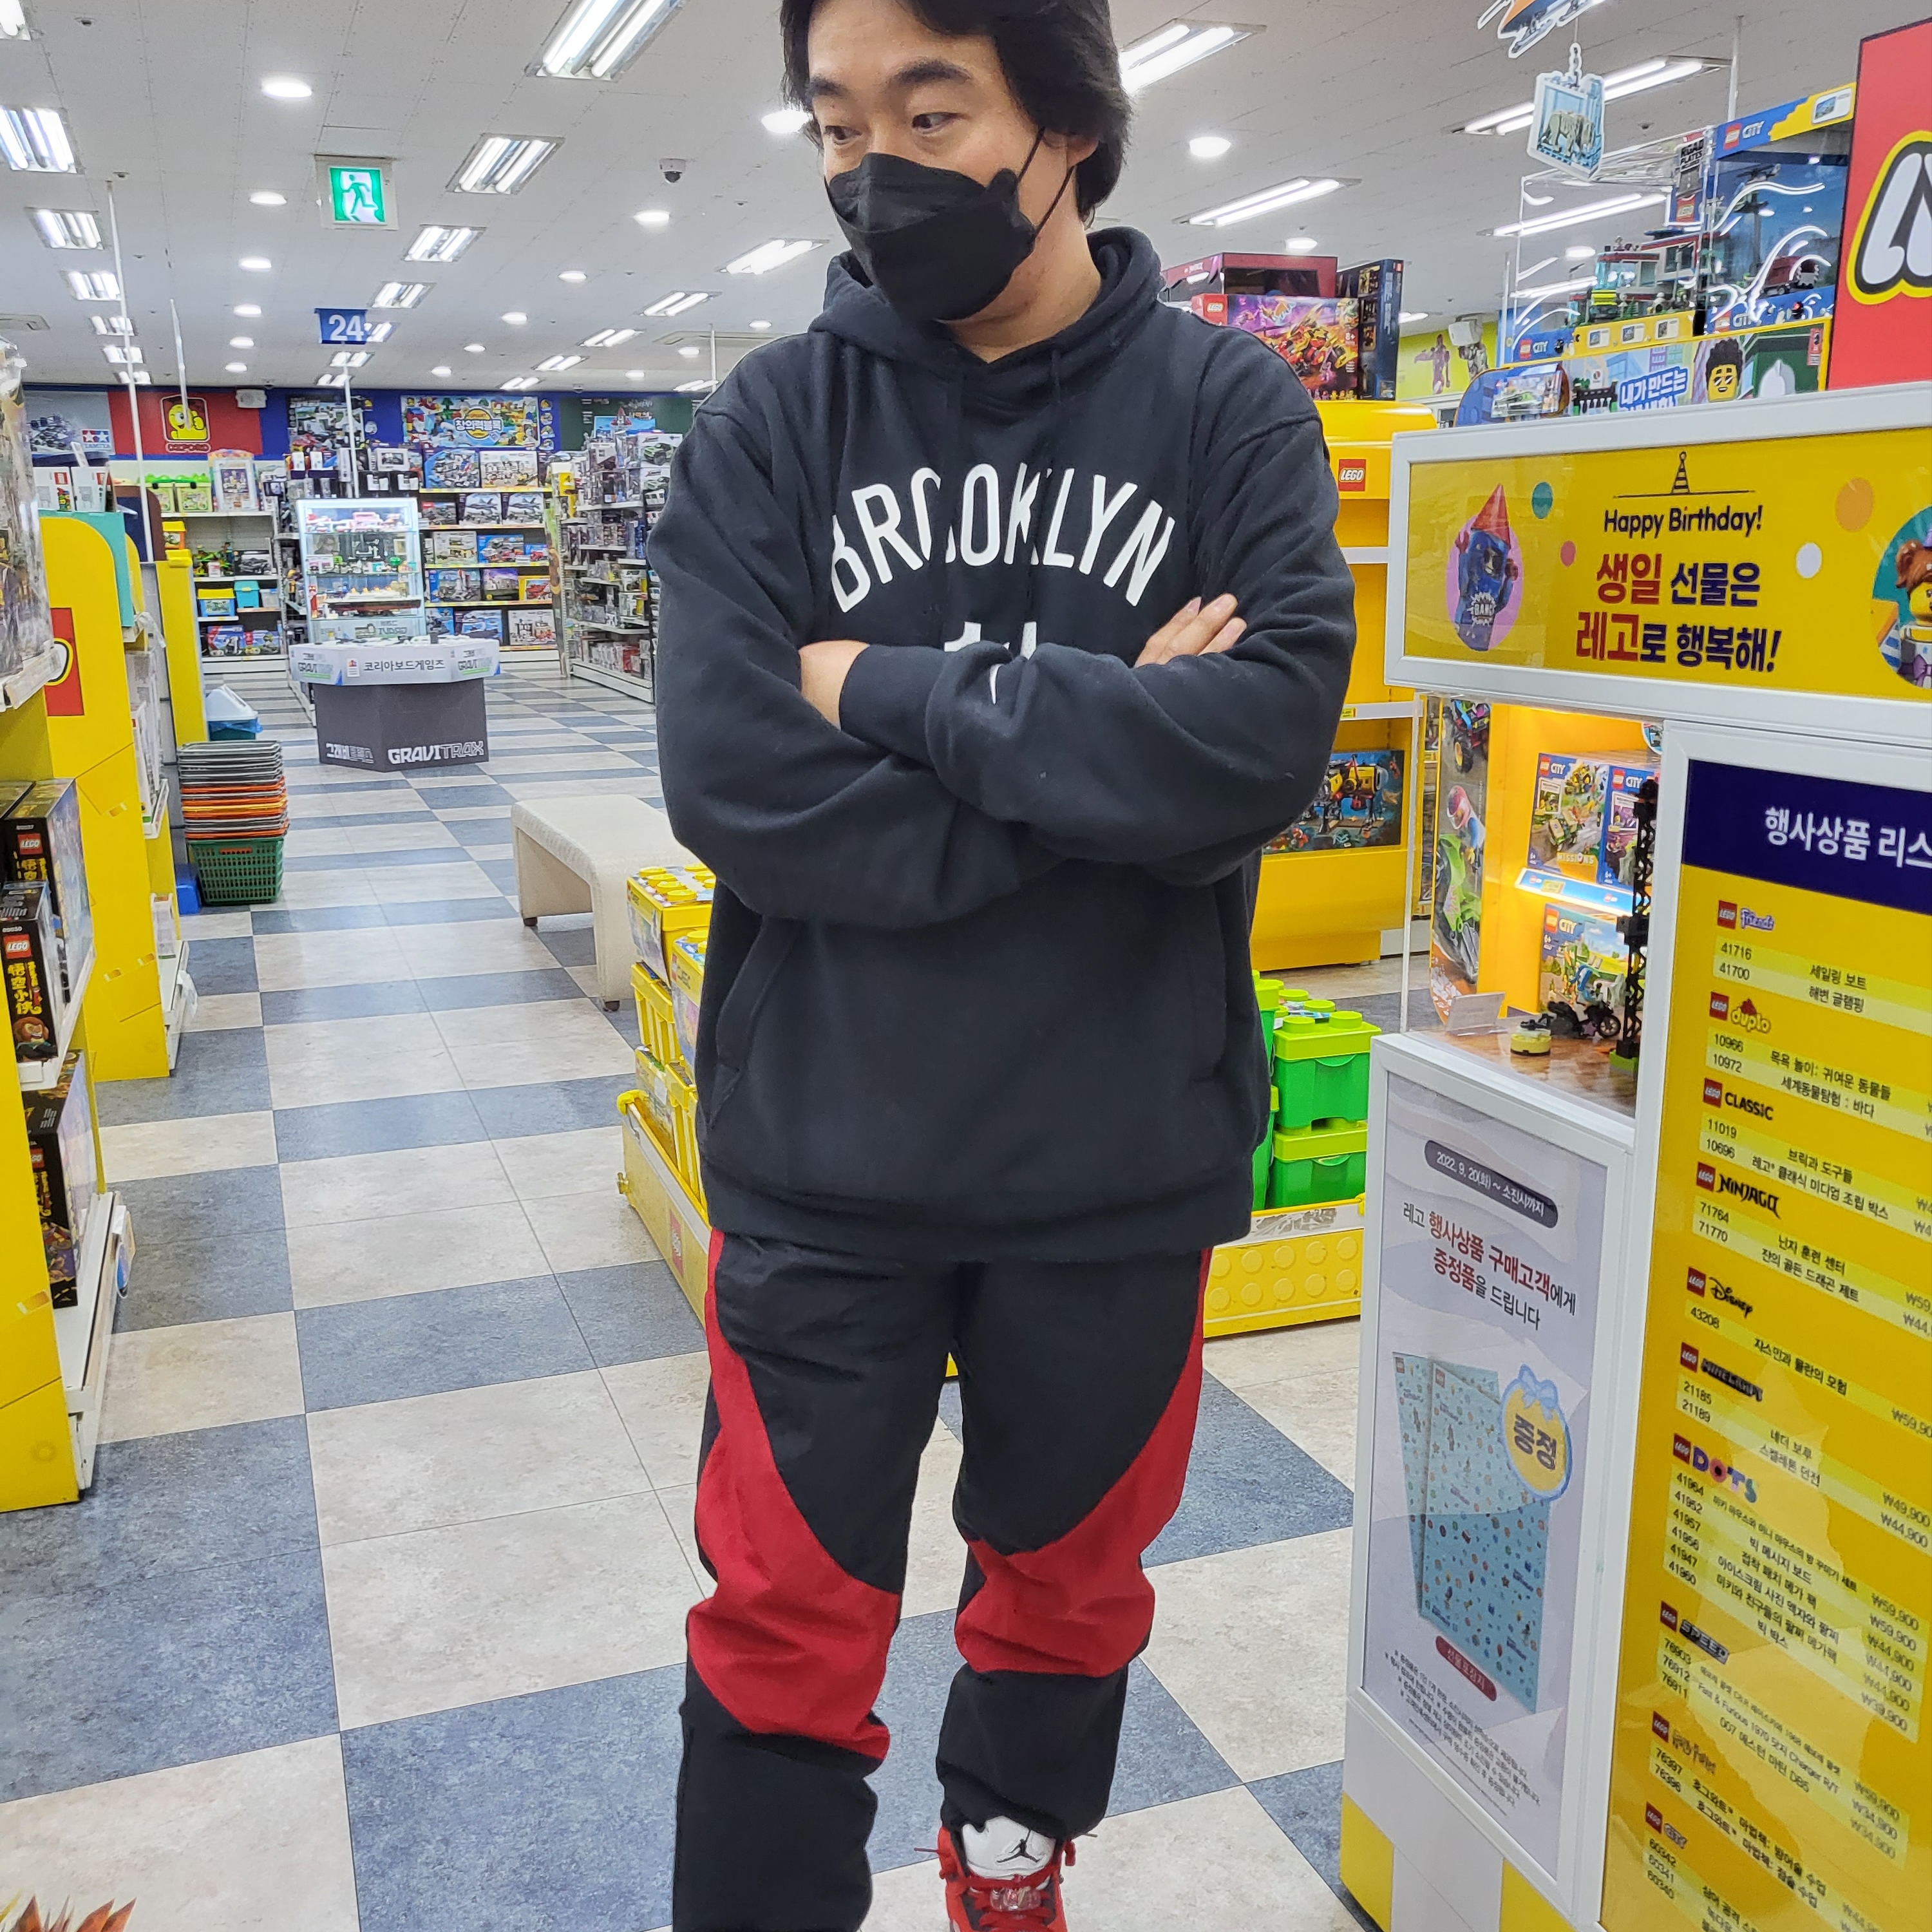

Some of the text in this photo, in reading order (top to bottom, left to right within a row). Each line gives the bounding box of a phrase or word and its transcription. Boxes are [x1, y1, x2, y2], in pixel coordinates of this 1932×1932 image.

[1743, 121, 1765, 139] CITY
[328, 315, 364, 341] 24
[1621, 379, 1646, 404] 내가
[1648, 370, 1686, 399] 만드는
[1340, 468, 1365, 482] LEGO
[1604, 505, 1763, 539] Happy Birthday!
[1596, 553, 1761, 607] 생일 선물은
[1576, 611, 1783, 673] 레고로 행복해!
[363, 659, 446, 672] 코리아보드게임즈
[388, 741, 484, 764] GRAVITRAX
[1551, 762, 1566, 775] CITY
[21, 840, 40, 848] LEGO
[1765, 806, 1871, 862] 행사상품
[1559, 918, 1577, 934] CITY
[7, 941, 28, 952] LEGO
[1721, 942, 1752, 960] 41716
[1719, 962, 1750, 980] 41700
[1844, 973, 1866, 990] 보트
[1713, 1054, 1742, 1073] 10972
[1823, 1066, 1853, 1089] 귀여운
[1725, 1092, 1774, 1121] CLASSIC
[1853, 1099, 1875, 1118] 바다
[1707, 1119, 1737, 1139] 11019
[1459, 1162, 1466, 1178] 9.
[1502, 1184, 1544, 1217] 소진시까지
[1717, 1174, 1781, 1219] NINJAGO
[1701, 1201, 1729, 1223] 71764
[1868, 1200, 1888, 1220] 박스
[1699, 1221, 1728, 1242] 71770
[1403, 1202, 1576, 1316] 레고 행사상품 구매고객에게
[1434, 1247, 1541, 1331] 증정품을 드립니다
[1709, 1276, 1753, 1319] Disney
[1514, 1414, 1557, 1470] 증정
[1692, 1446, 1757, 1503] DOTS
[1718, 1555, 1762, 1593] 아이스크림
